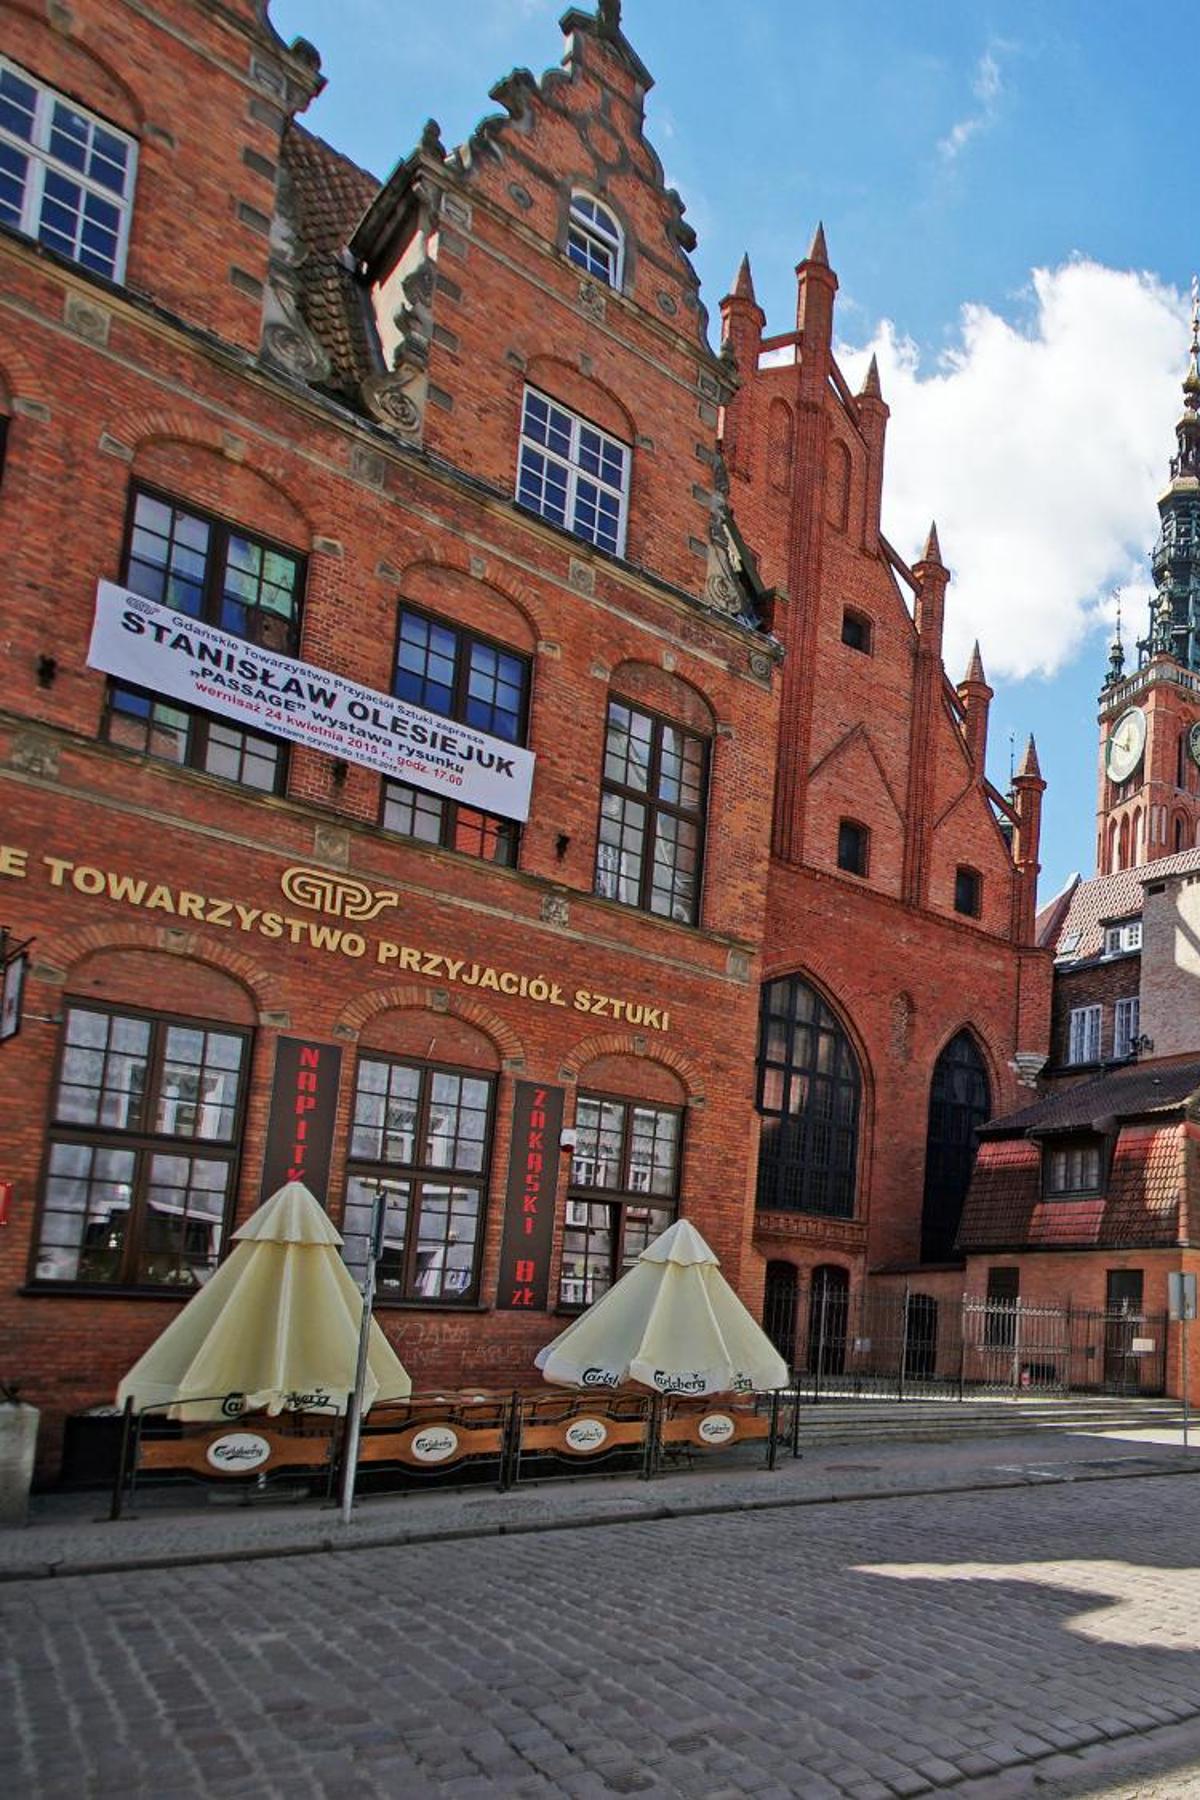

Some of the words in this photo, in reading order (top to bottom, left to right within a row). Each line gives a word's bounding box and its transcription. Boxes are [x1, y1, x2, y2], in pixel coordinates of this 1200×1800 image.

[121, 611, 337, 710] STANISŁAW
[347, 700, 516, 779] OLESIEJUK
[244, 645, 331, 686] Towarzystwo
[397, 705, 434, 726] Sztuki
[436, 721, 485, 745] zaprasza
[265, 708, 283, 721] 24
[287, 715, 343, 742] kwietnia
[347, 736, 378, 755] 2015
[311, 710, 392, 747] wystawa
[398, 743, 464, 774] rysunku
[43, 856, 366, 958] TOWARZYSTWO
[377, 941, 566, 1007] PRZYJACIÓŁ
[573, 990, 670, 1032] SZTUKI
[654, 1369, 707, 1394] Carlsberg
[214, 1444, 264, 1461] Carlsberg
